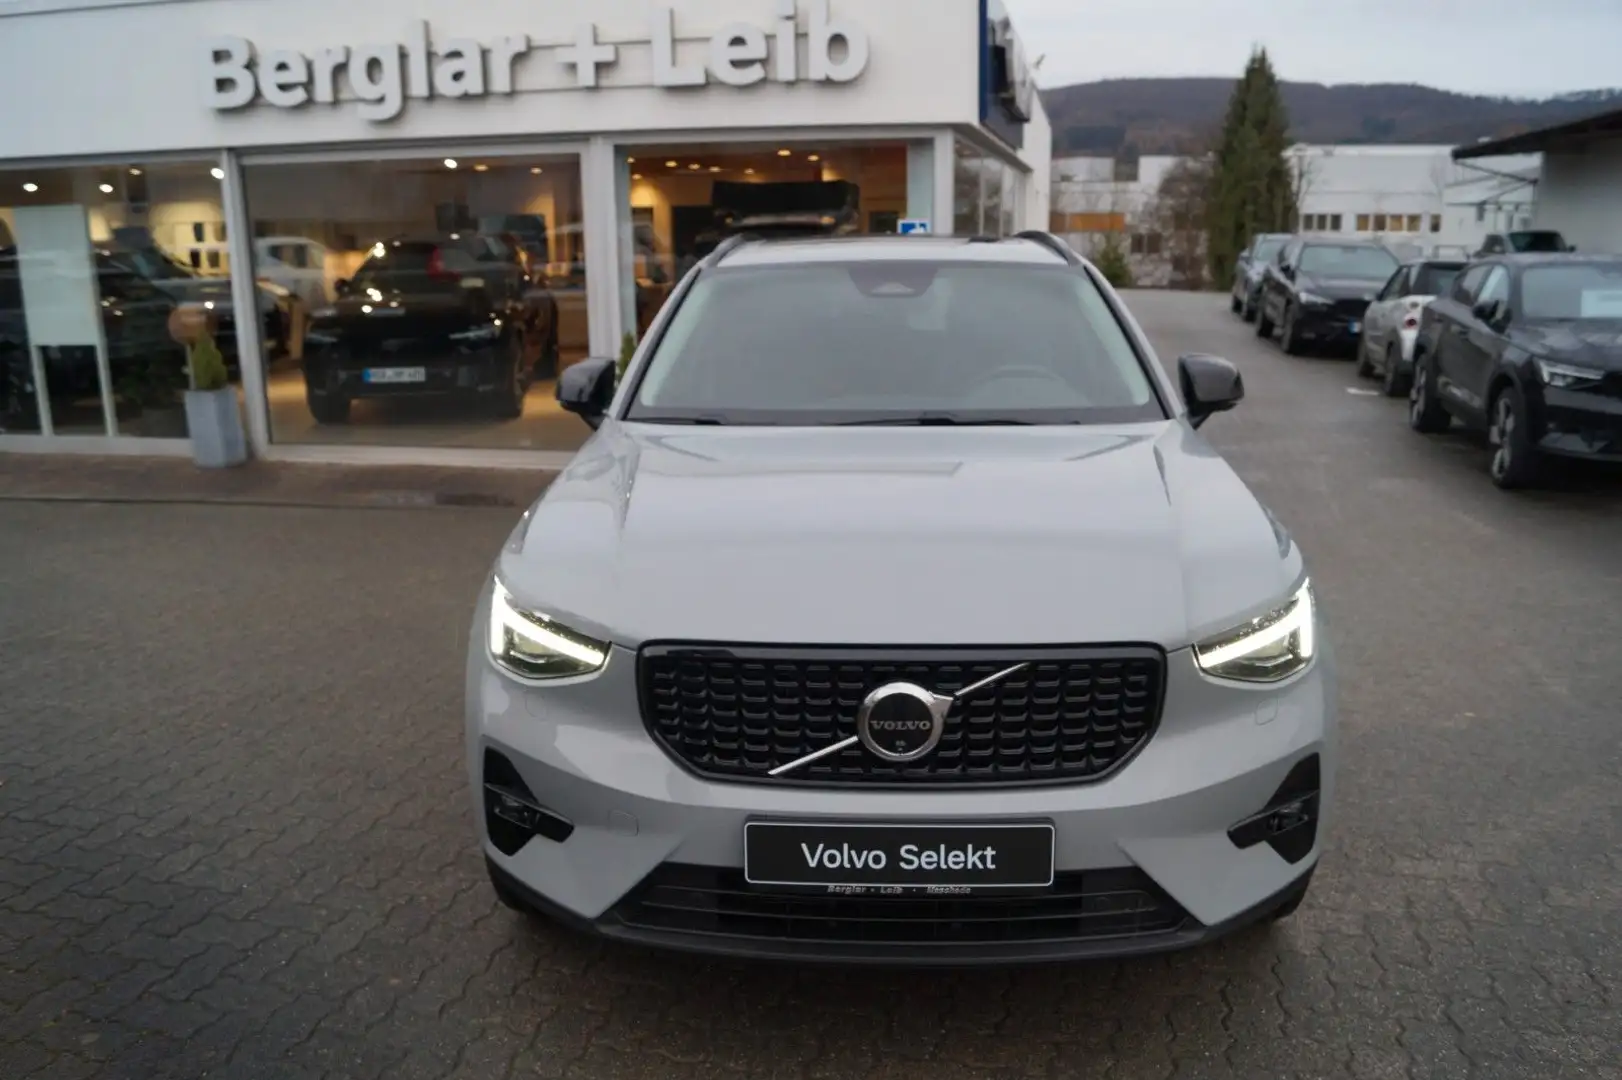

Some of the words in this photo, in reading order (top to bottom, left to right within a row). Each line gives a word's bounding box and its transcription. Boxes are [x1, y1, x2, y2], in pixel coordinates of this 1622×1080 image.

[202, 19, 529, 121] Berglar
[556, 23, 615, 88] +
[651, 0, 869, 87] Leib
[870, 720, 932, 730] VOLVO
[801, 843, 886, 869] Volvo
[899, 844, 996, 869] Selekt
